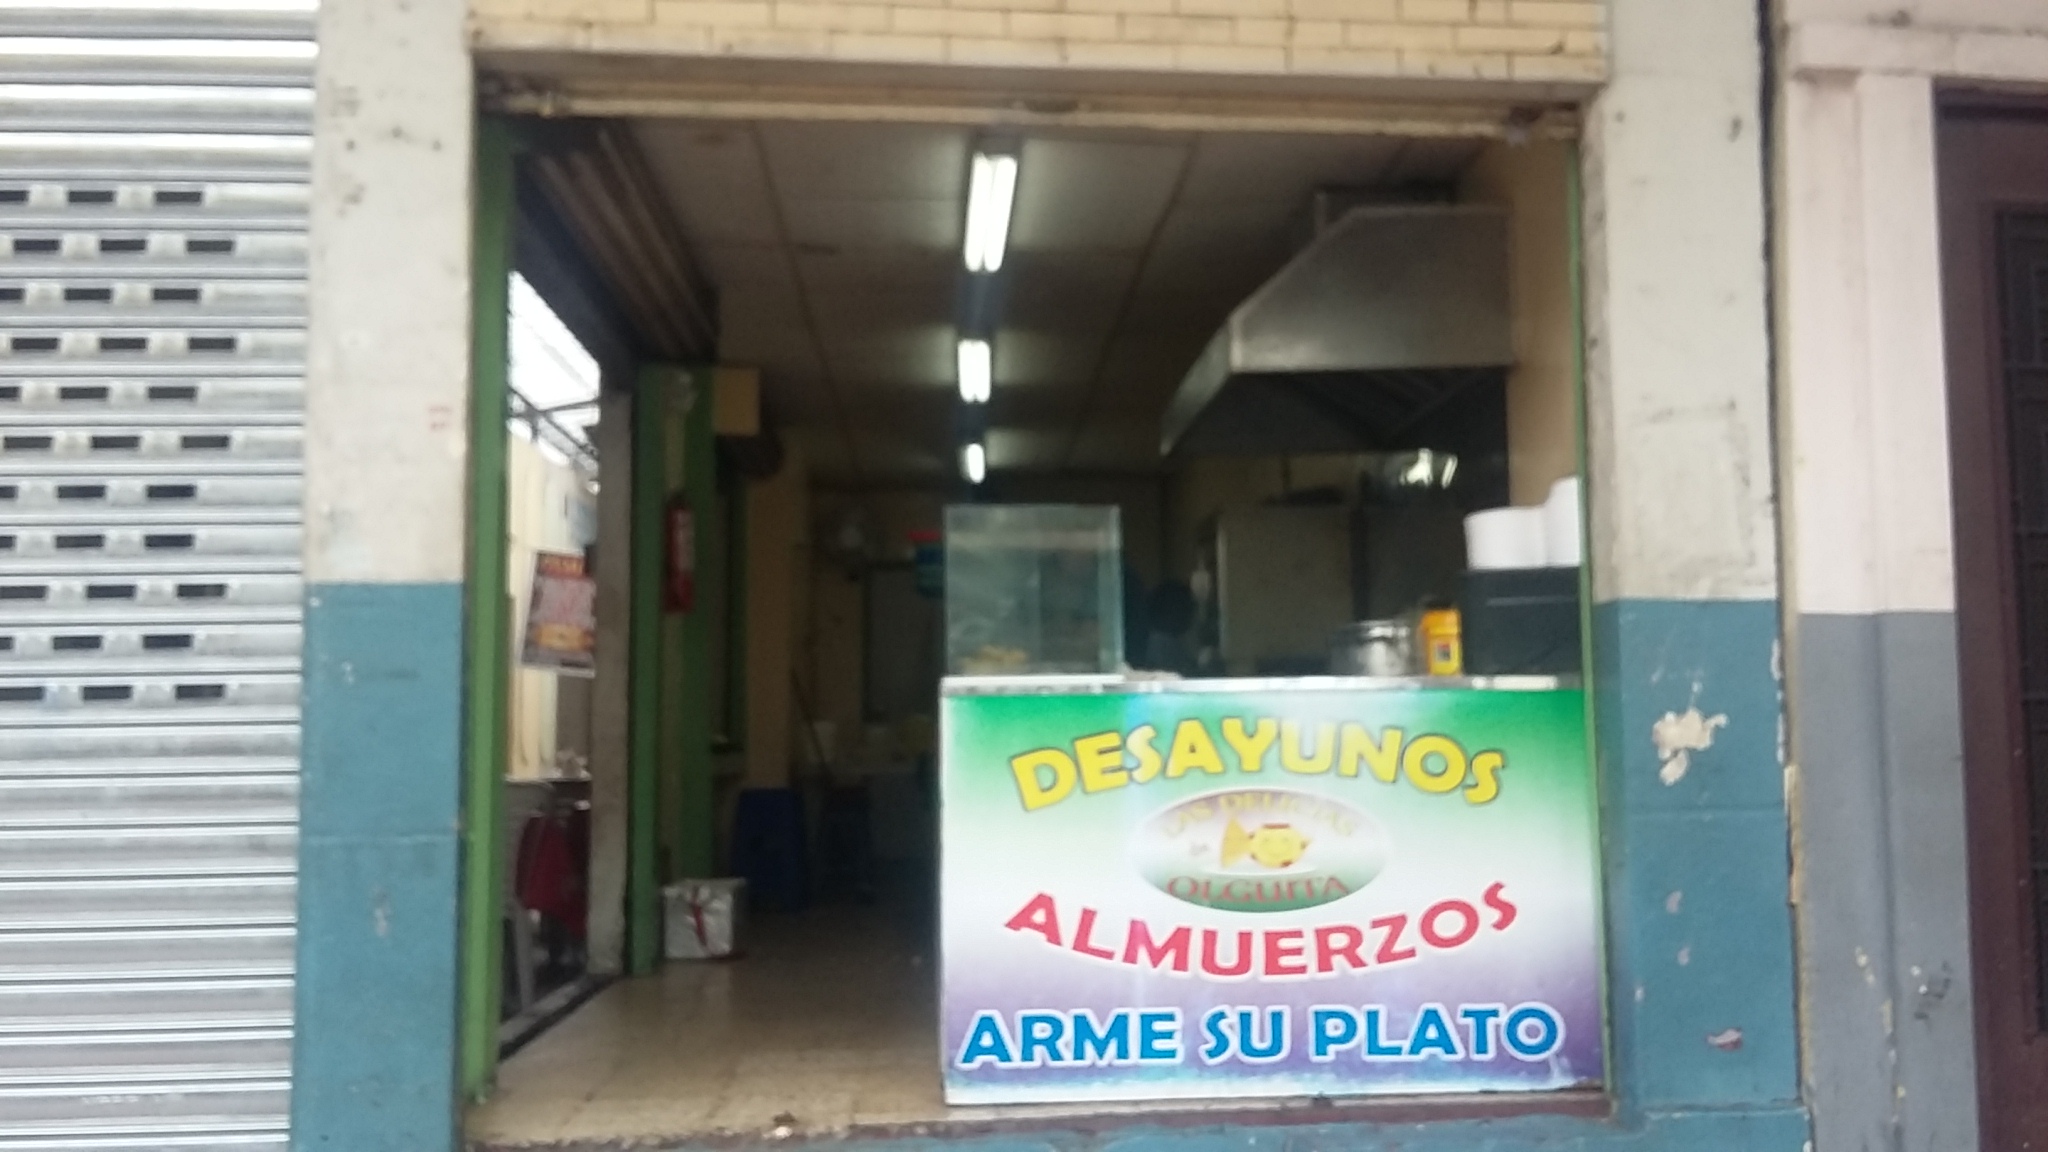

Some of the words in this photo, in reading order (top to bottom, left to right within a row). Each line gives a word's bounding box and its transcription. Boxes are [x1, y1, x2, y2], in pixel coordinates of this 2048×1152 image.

[1010, 717, 1505, 811] DESAYUNOS
[1166, 875, 1350, 904] OLGUITA
[1004, 883, 1518, 977] ALMUERZOS
[960, 1012, 1182, 1065] ARME
[1199, 1010, 1286, 1062] SU
[1312, 1006, 1561, 1060] PLATO
